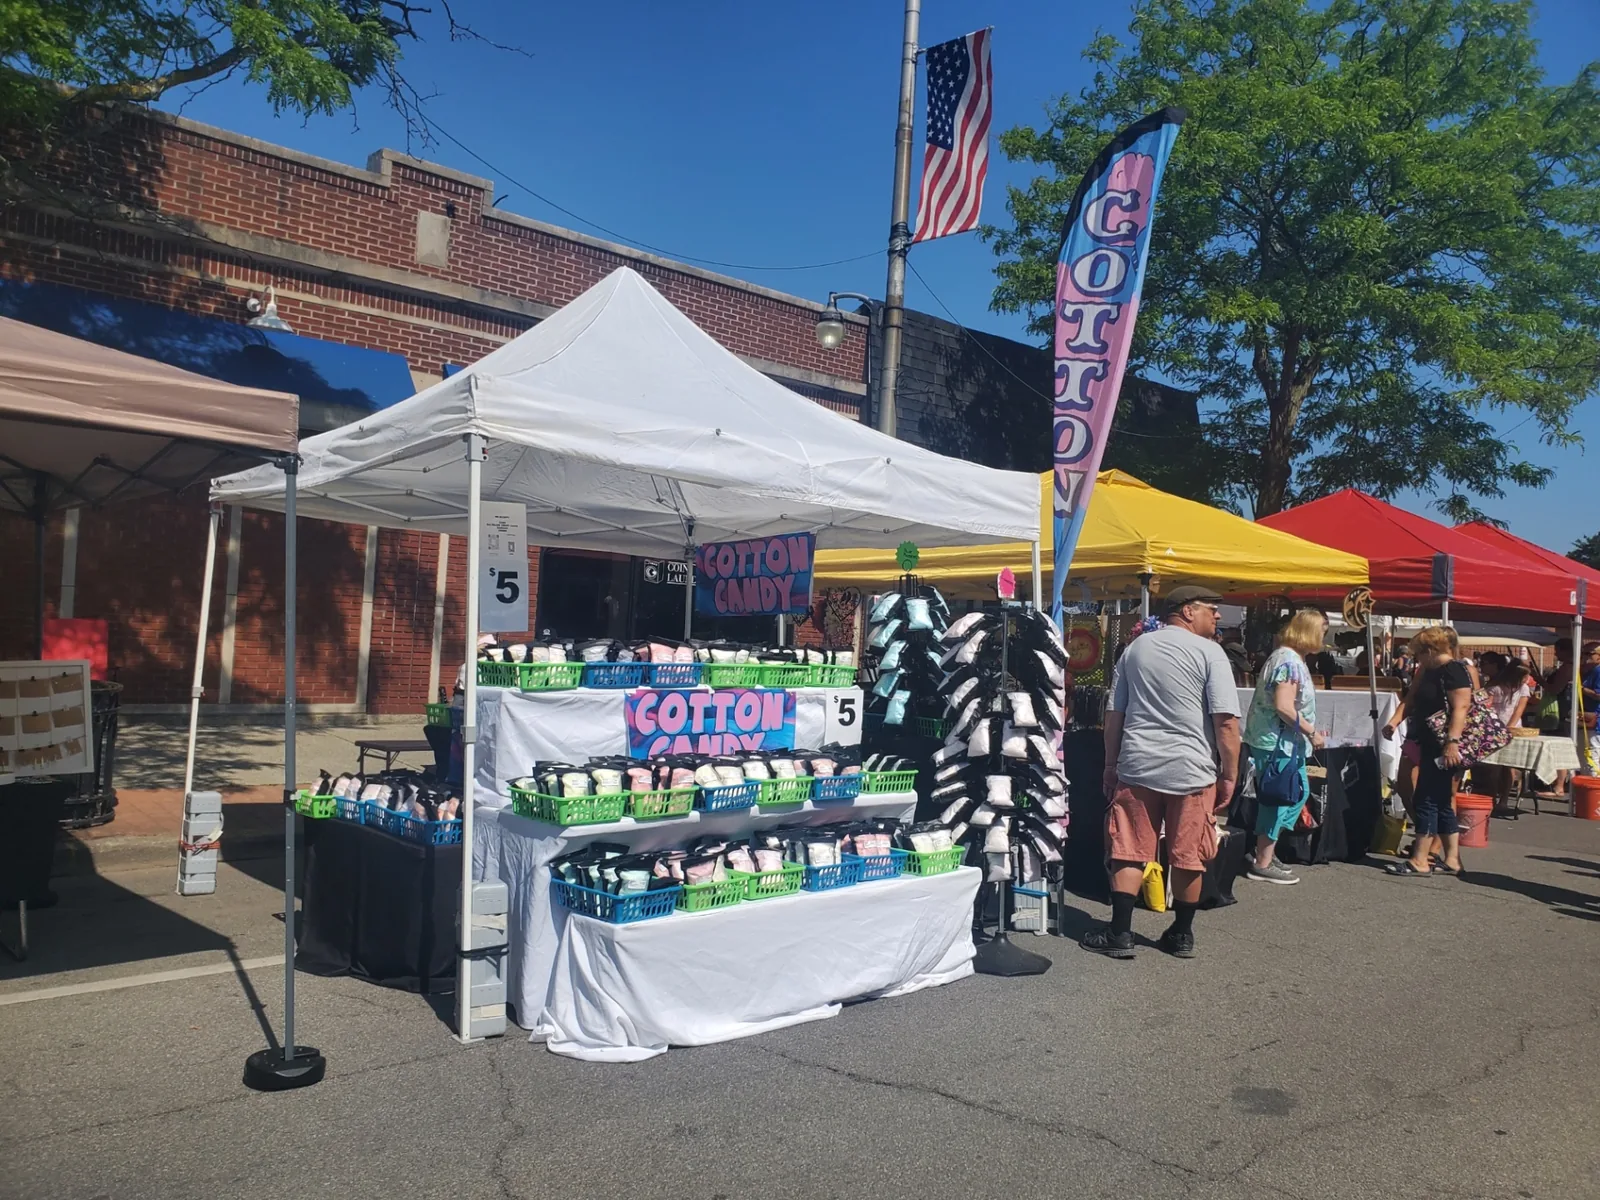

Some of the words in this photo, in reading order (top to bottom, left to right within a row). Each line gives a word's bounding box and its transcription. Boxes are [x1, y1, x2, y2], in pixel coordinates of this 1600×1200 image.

[704, 536, 809, 579] COTTON
[489, 567, 520, 604] $5
[714, 575, 796, 613] CANDY
[635, 692, 785, 735] COTTON
[833, 695, 856, 727] $5
